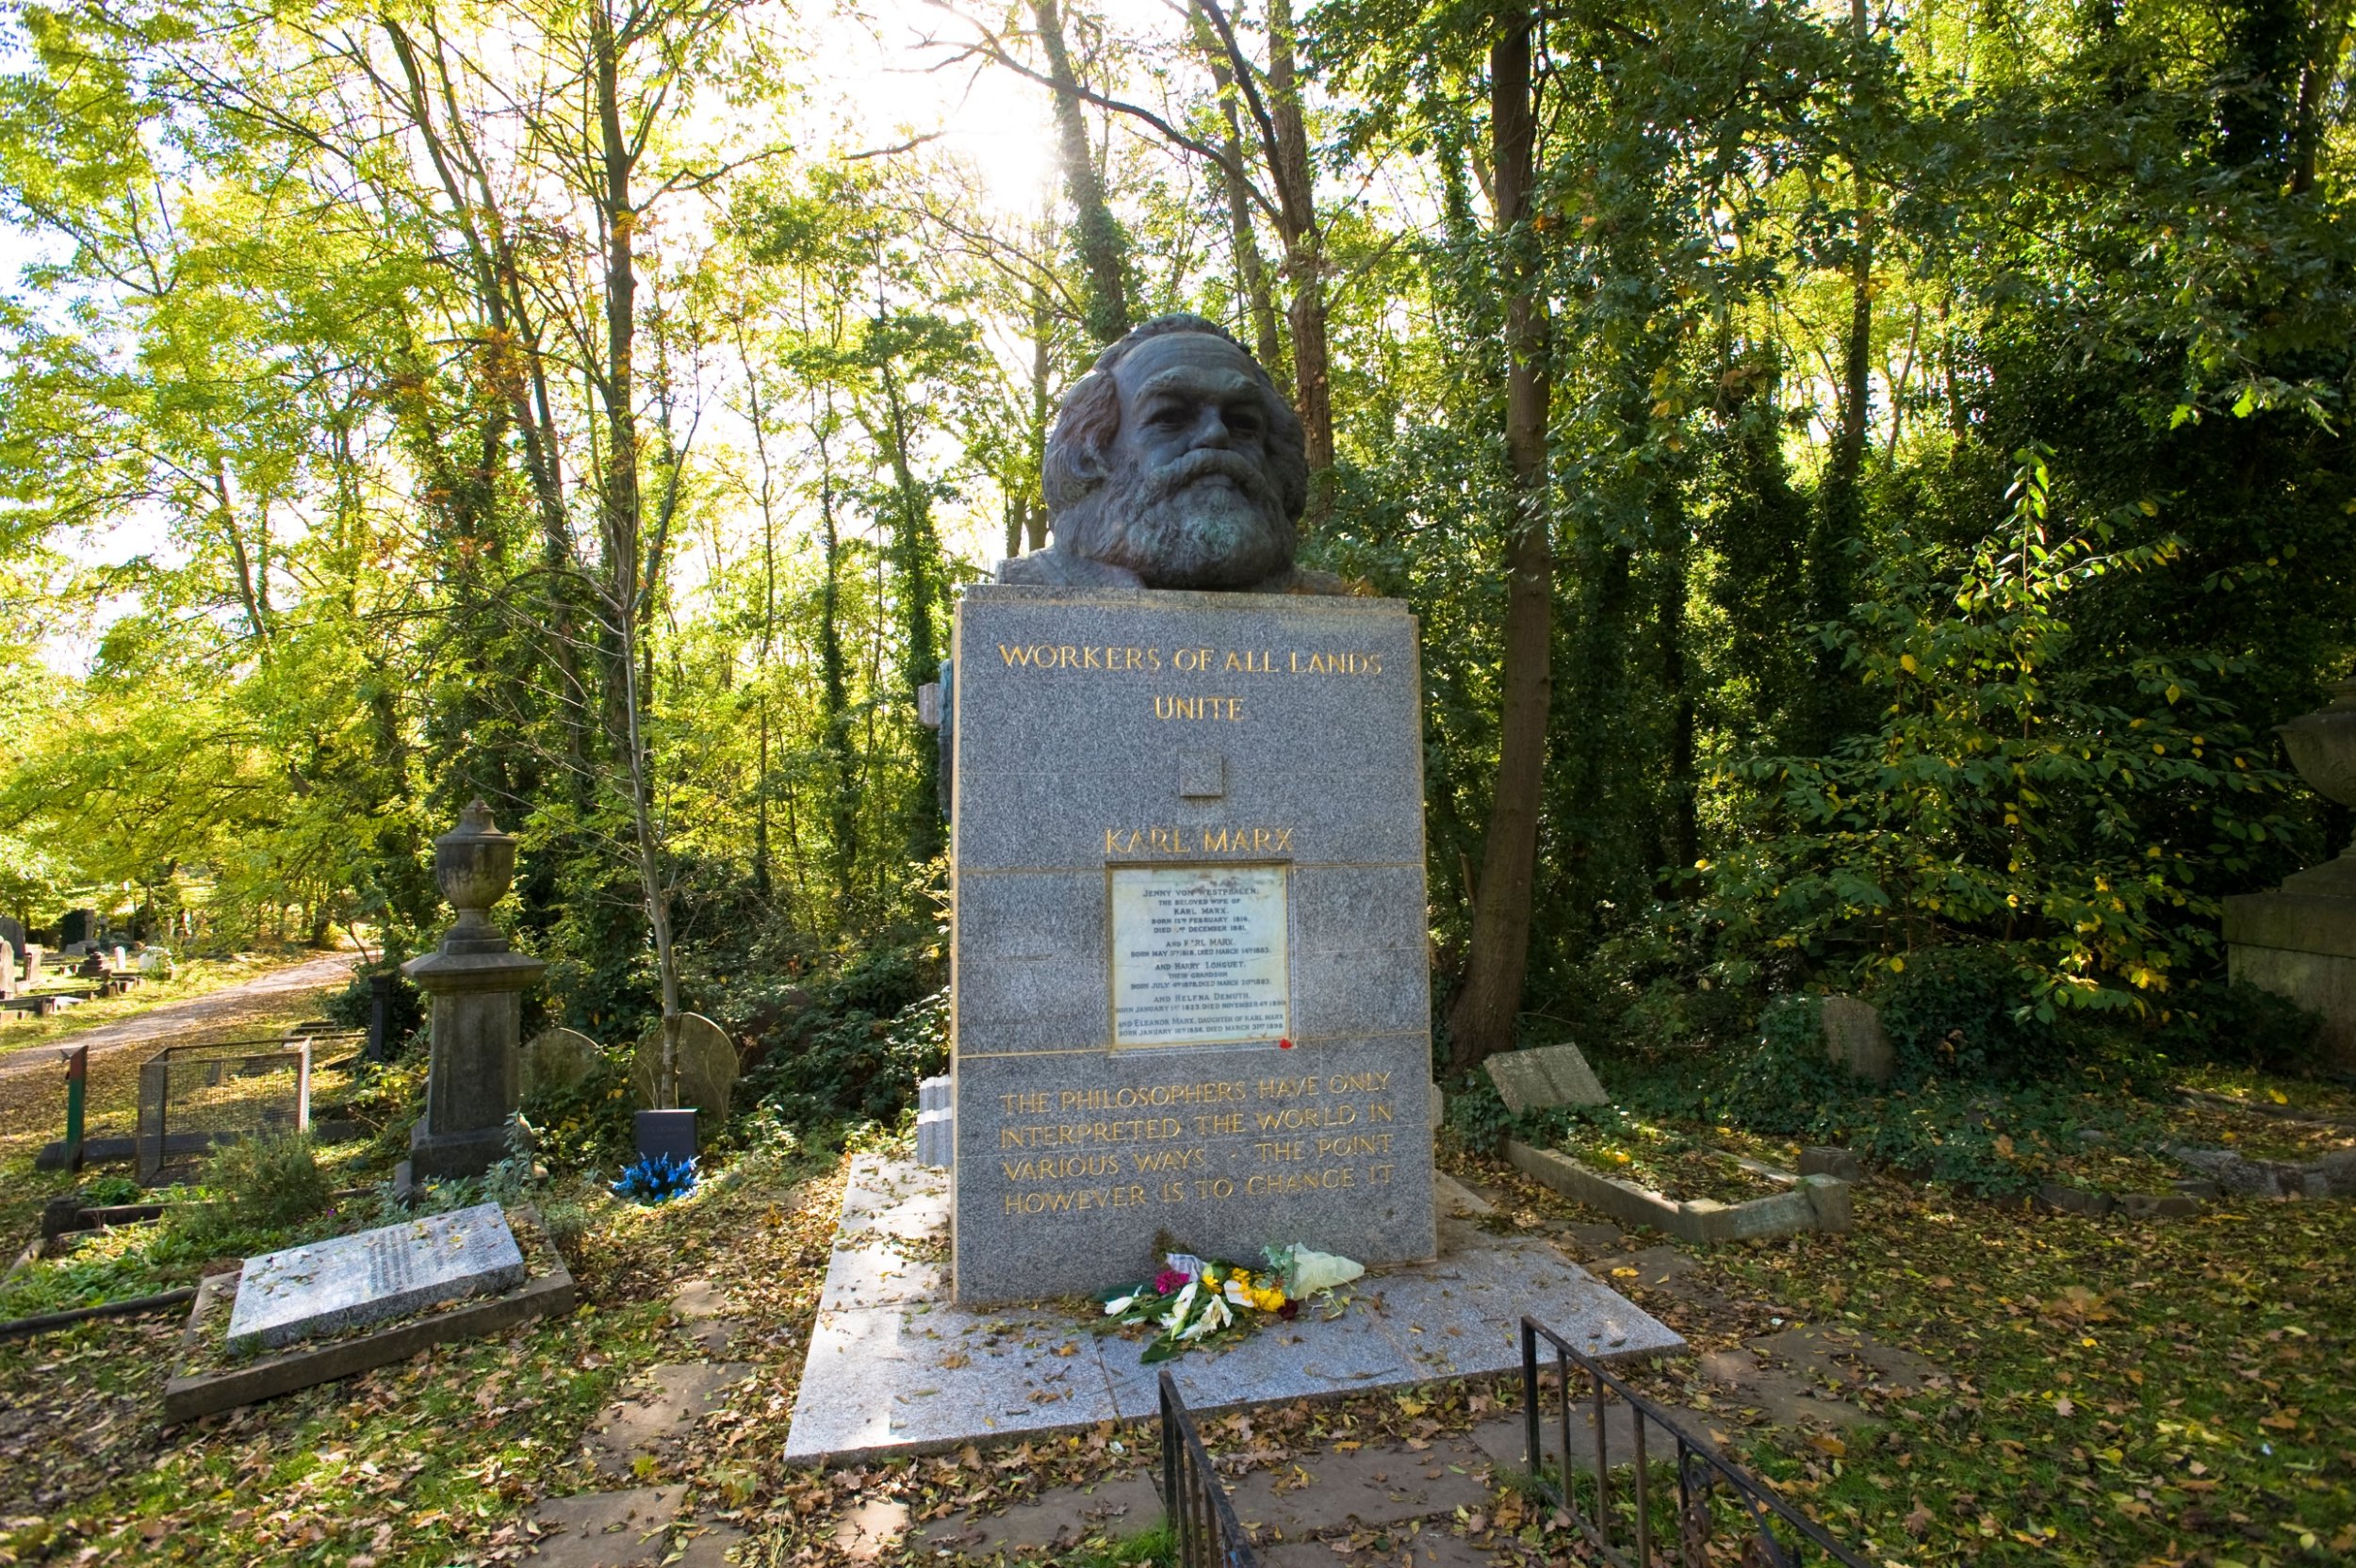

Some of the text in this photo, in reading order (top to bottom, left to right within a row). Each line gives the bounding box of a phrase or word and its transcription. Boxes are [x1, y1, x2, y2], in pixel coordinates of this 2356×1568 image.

[999, 644, 1382, 675] WORKERS OF ALL LANDS
[1154, 696, 1245, 721] UNITE
[1104, 827, 1294, 854] KARL MARX
[1142, 890, 1171, 898] JENNY
[1173, 907, 1197, 916] KARL
[1188, 916, 1228, 924] FEBRUARY
[1155, 963, 1171, 972] AND
[1174, 994, 1210, 1003] HELENA
[1135, 1004, 1170, 1014] JANUARY
[1134, 1019, 1170, 1027] ELEANOR
[1198, 1016, 1234, 1024] DAUGHTER
[1138, 1028, 1172, 1037] JANUARY
[1225, 1023, 1250, 1032] MARCH
[1000, 1070, 1391, 1116] THE PHILOSOPHERS HAVE ONLY
[1001, 1103, 1392, 1149] INTERPRETED THE WORLD IN
[1003, 1134, 1394, 1182] VARIOUS WAYS THE POINT
[1005, 1165, 1395, 1216] HOWEVER IS TO CHANGE IT
